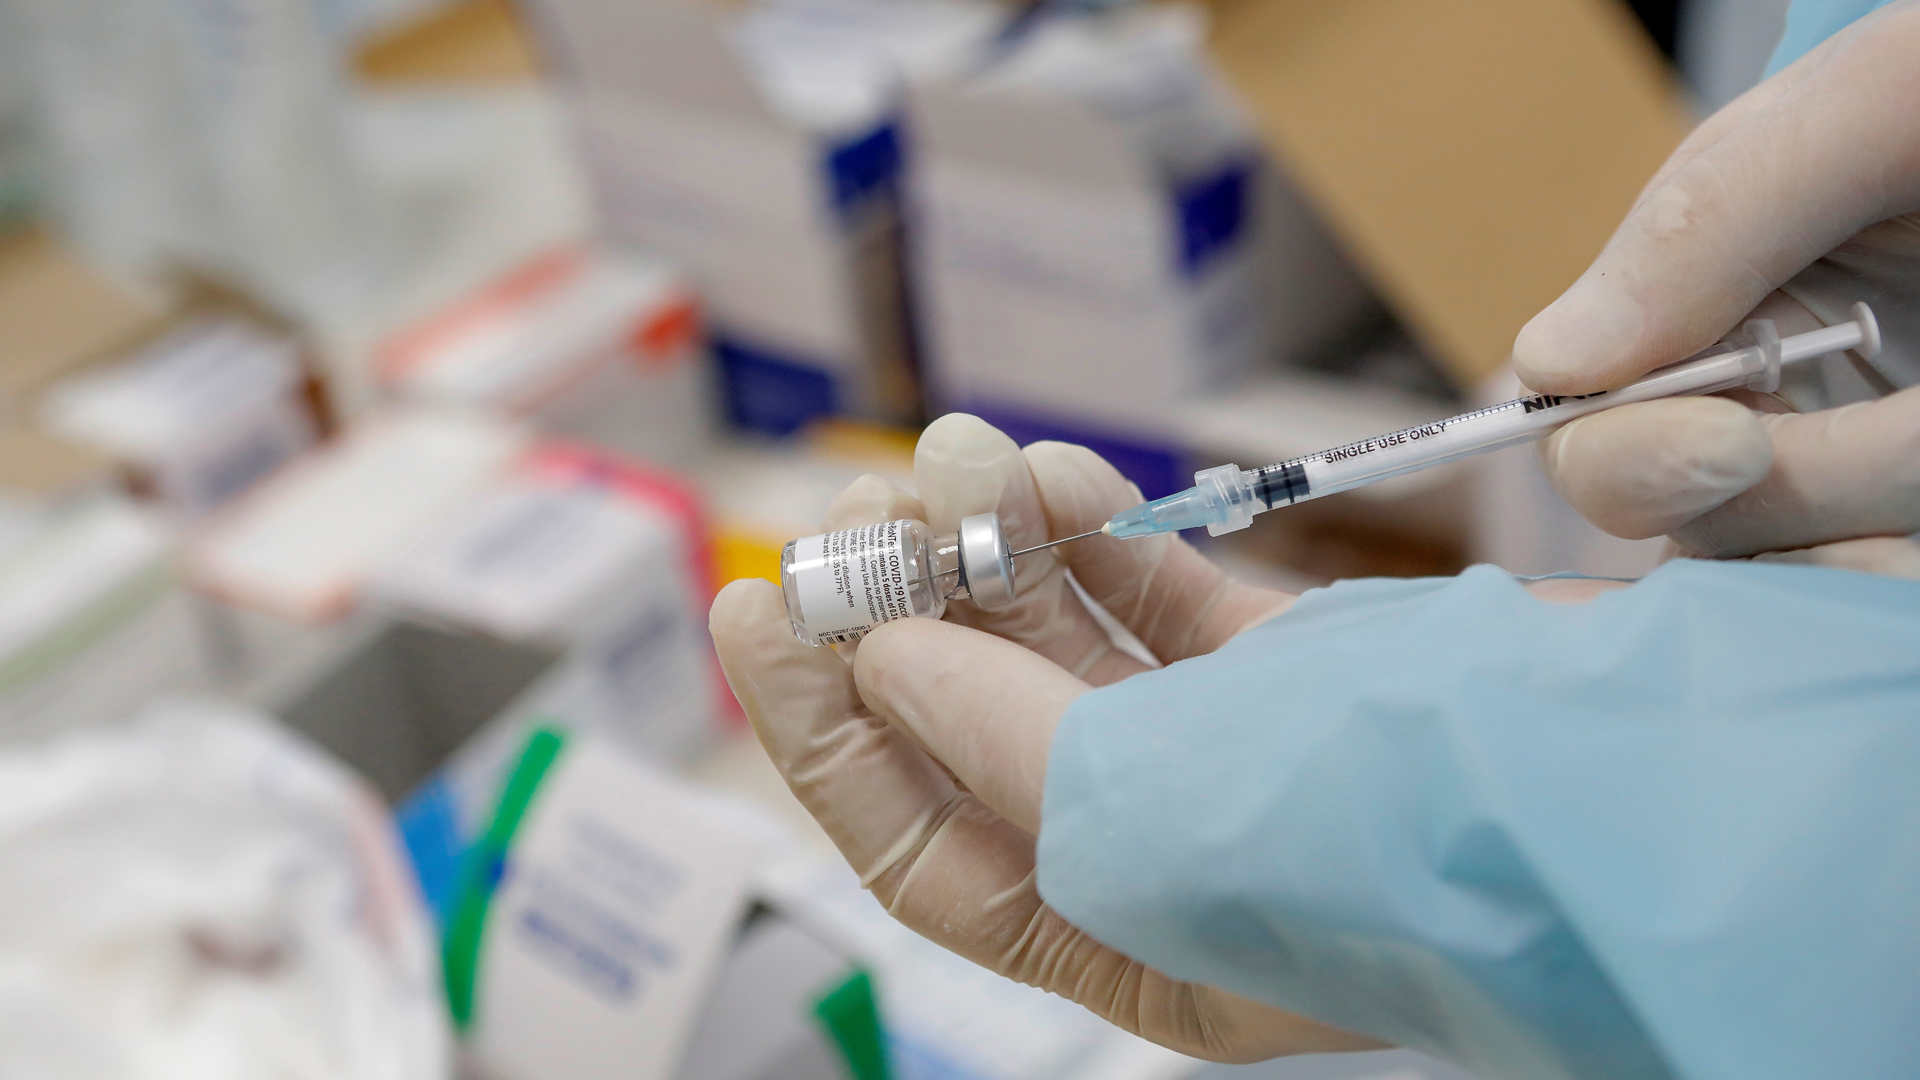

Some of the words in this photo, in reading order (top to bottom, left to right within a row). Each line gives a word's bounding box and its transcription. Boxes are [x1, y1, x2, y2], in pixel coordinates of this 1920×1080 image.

[1324, 443, 1376, 464] SINGLE
[1378, 433, 1407, 449] USE
[1410, 421, 1447, 440] ONLY
[859, 541, 867, 572] Emergency
[870, 560, 880, 586] Contains
[879, 551, 887, 577] contains
[883, 583, 893, 602] doses
[889, 555, 904, 596] COVID-19
[842, 565, 850, 590] dilution
[846, 590, 854, 608] when
